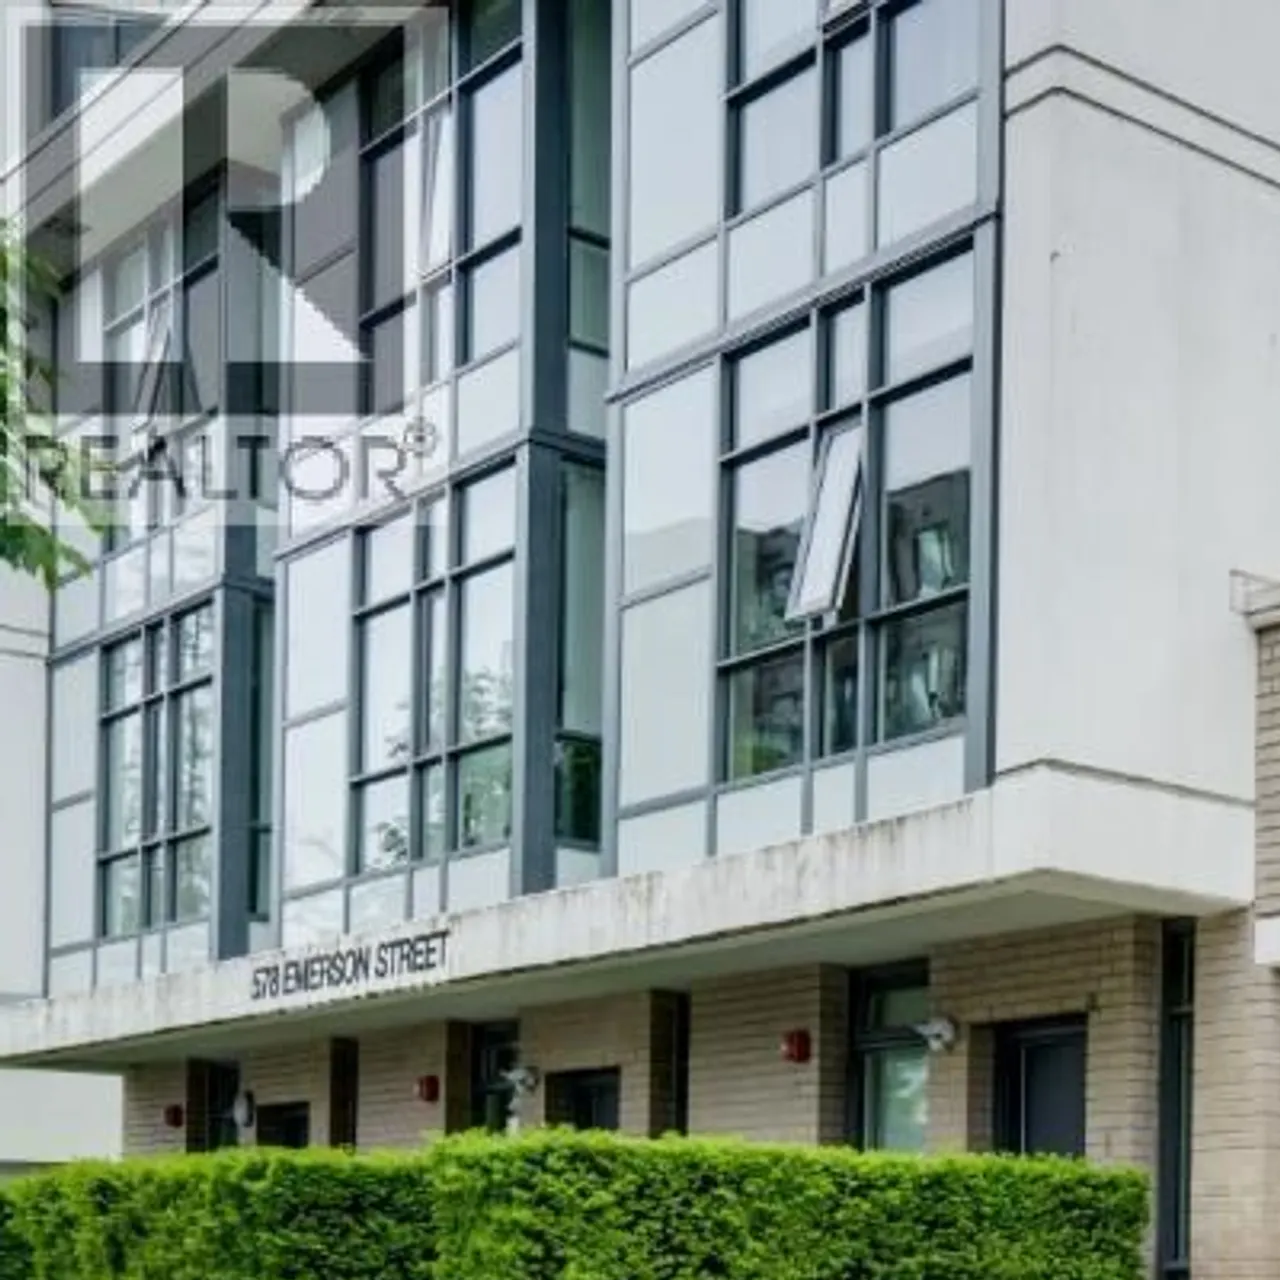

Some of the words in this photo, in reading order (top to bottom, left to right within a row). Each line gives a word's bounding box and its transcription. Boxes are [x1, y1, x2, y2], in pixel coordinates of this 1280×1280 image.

[252, 964, 279, 999] 578
[282, 948, 370, 995] EMERSON
[373, 928, 450, 979] STREET
